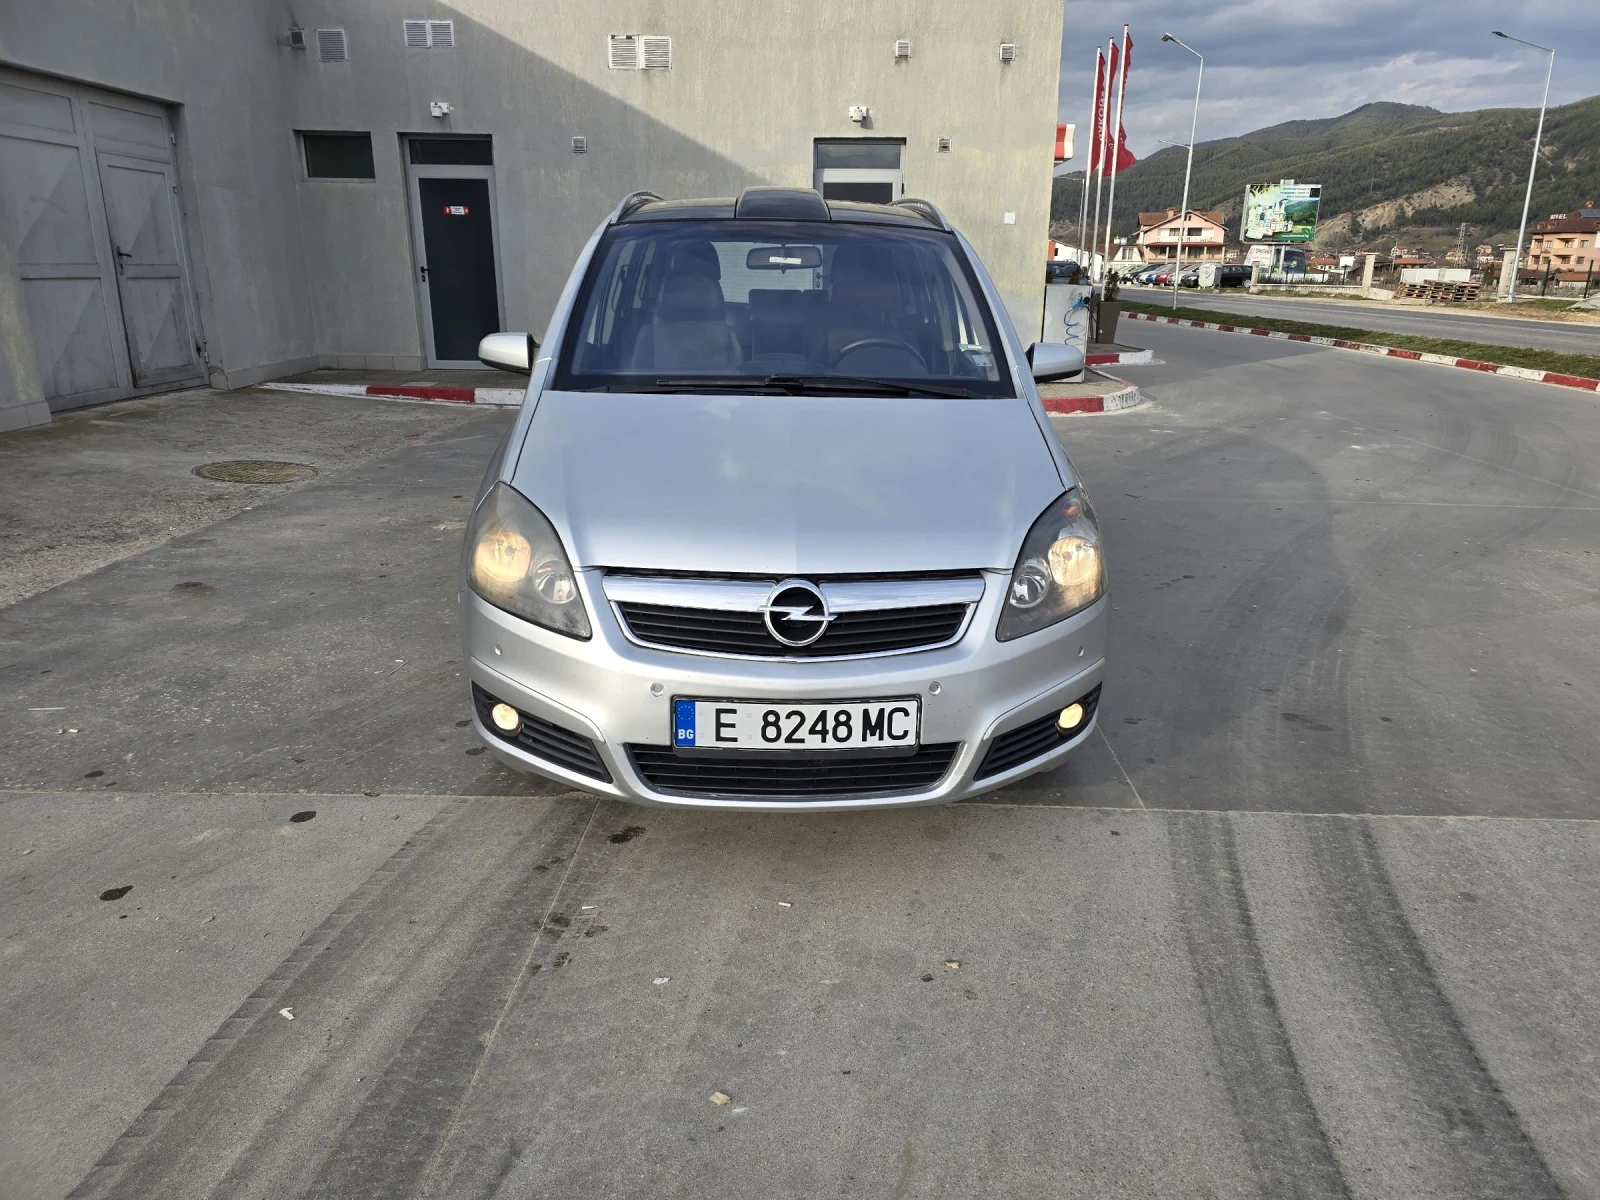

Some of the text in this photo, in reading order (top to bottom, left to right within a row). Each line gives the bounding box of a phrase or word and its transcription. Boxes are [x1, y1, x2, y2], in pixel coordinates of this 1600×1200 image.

[677, 728, 694, 740] BG
[714, 706, 910, 744] E 8248 MC
